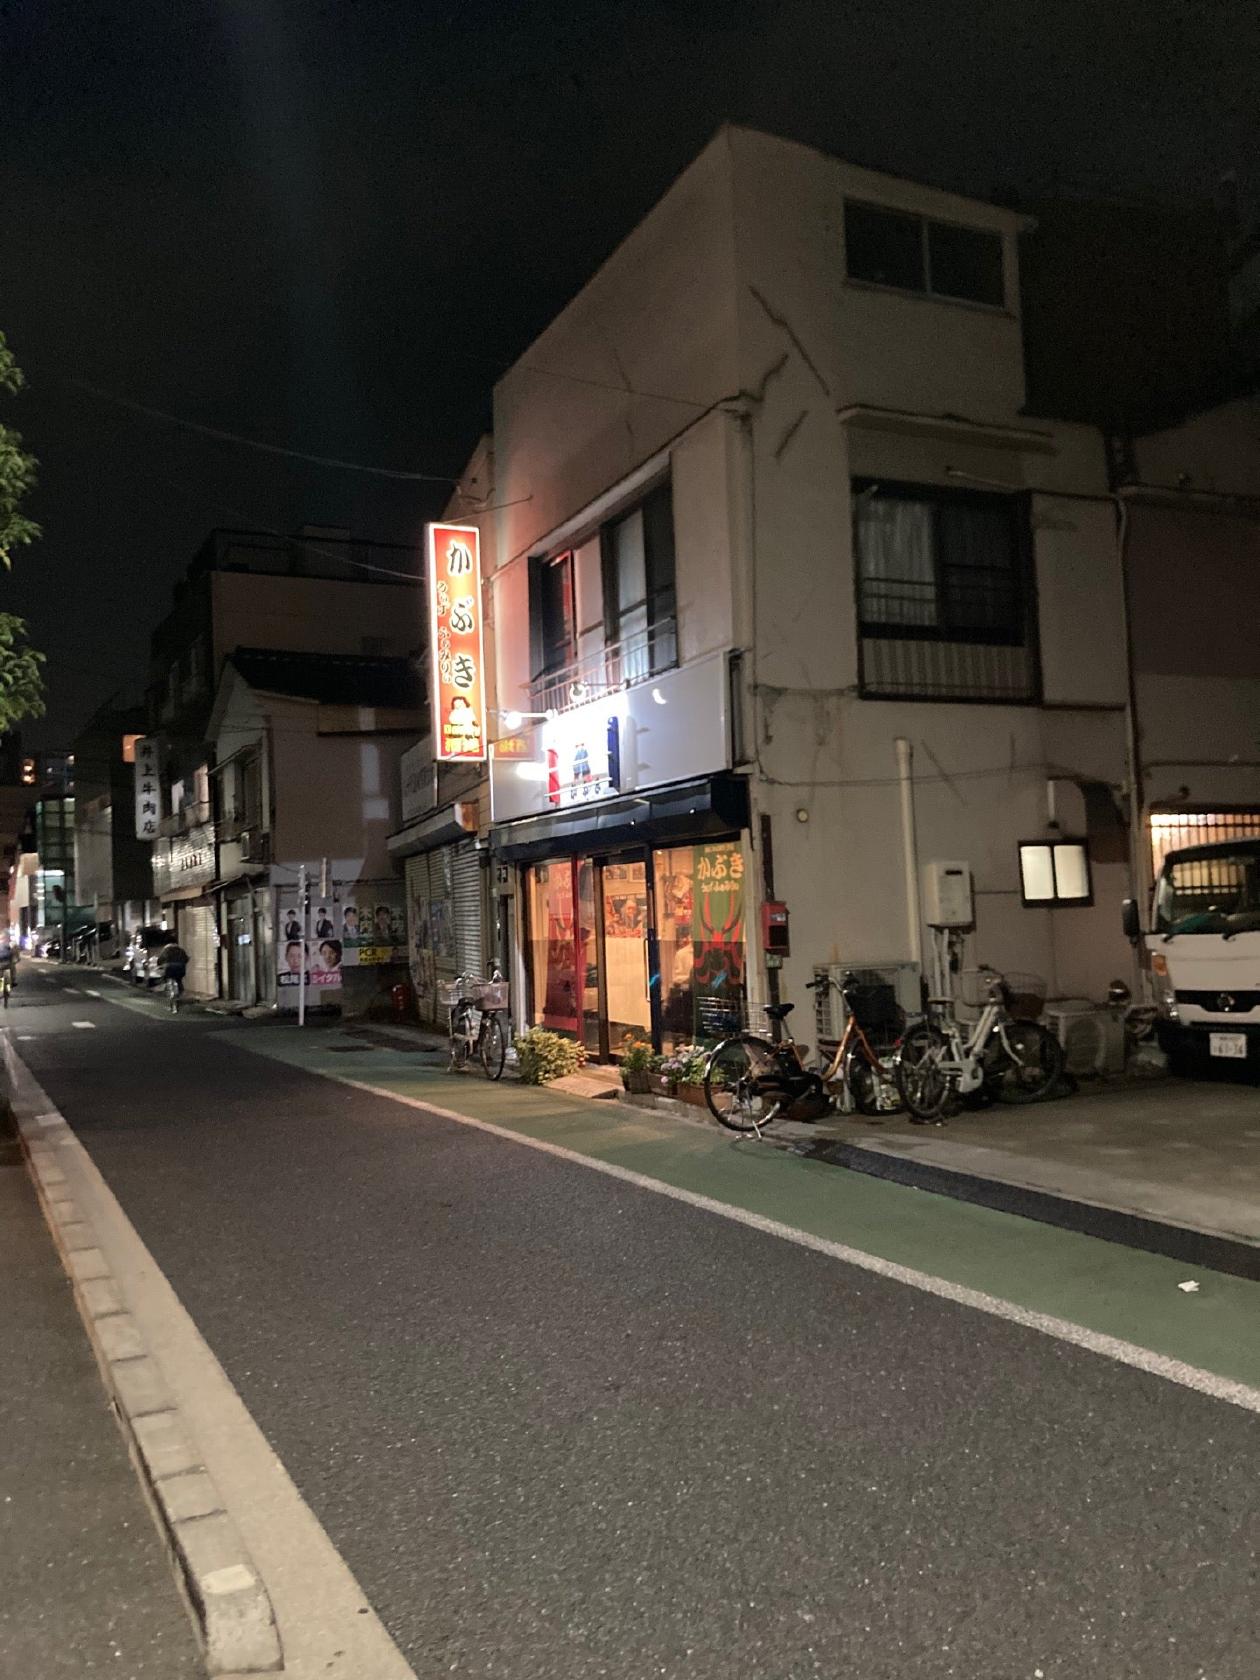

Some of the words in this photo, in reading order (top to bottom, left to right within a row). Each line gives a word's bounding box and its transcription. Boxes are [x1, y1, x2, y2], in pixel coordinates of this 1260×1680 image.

[449, 544, 474, 689] かぶき
[140, 745, 156, 835] 井上牛肉店
[697, 852, 744, 881] かぶき
